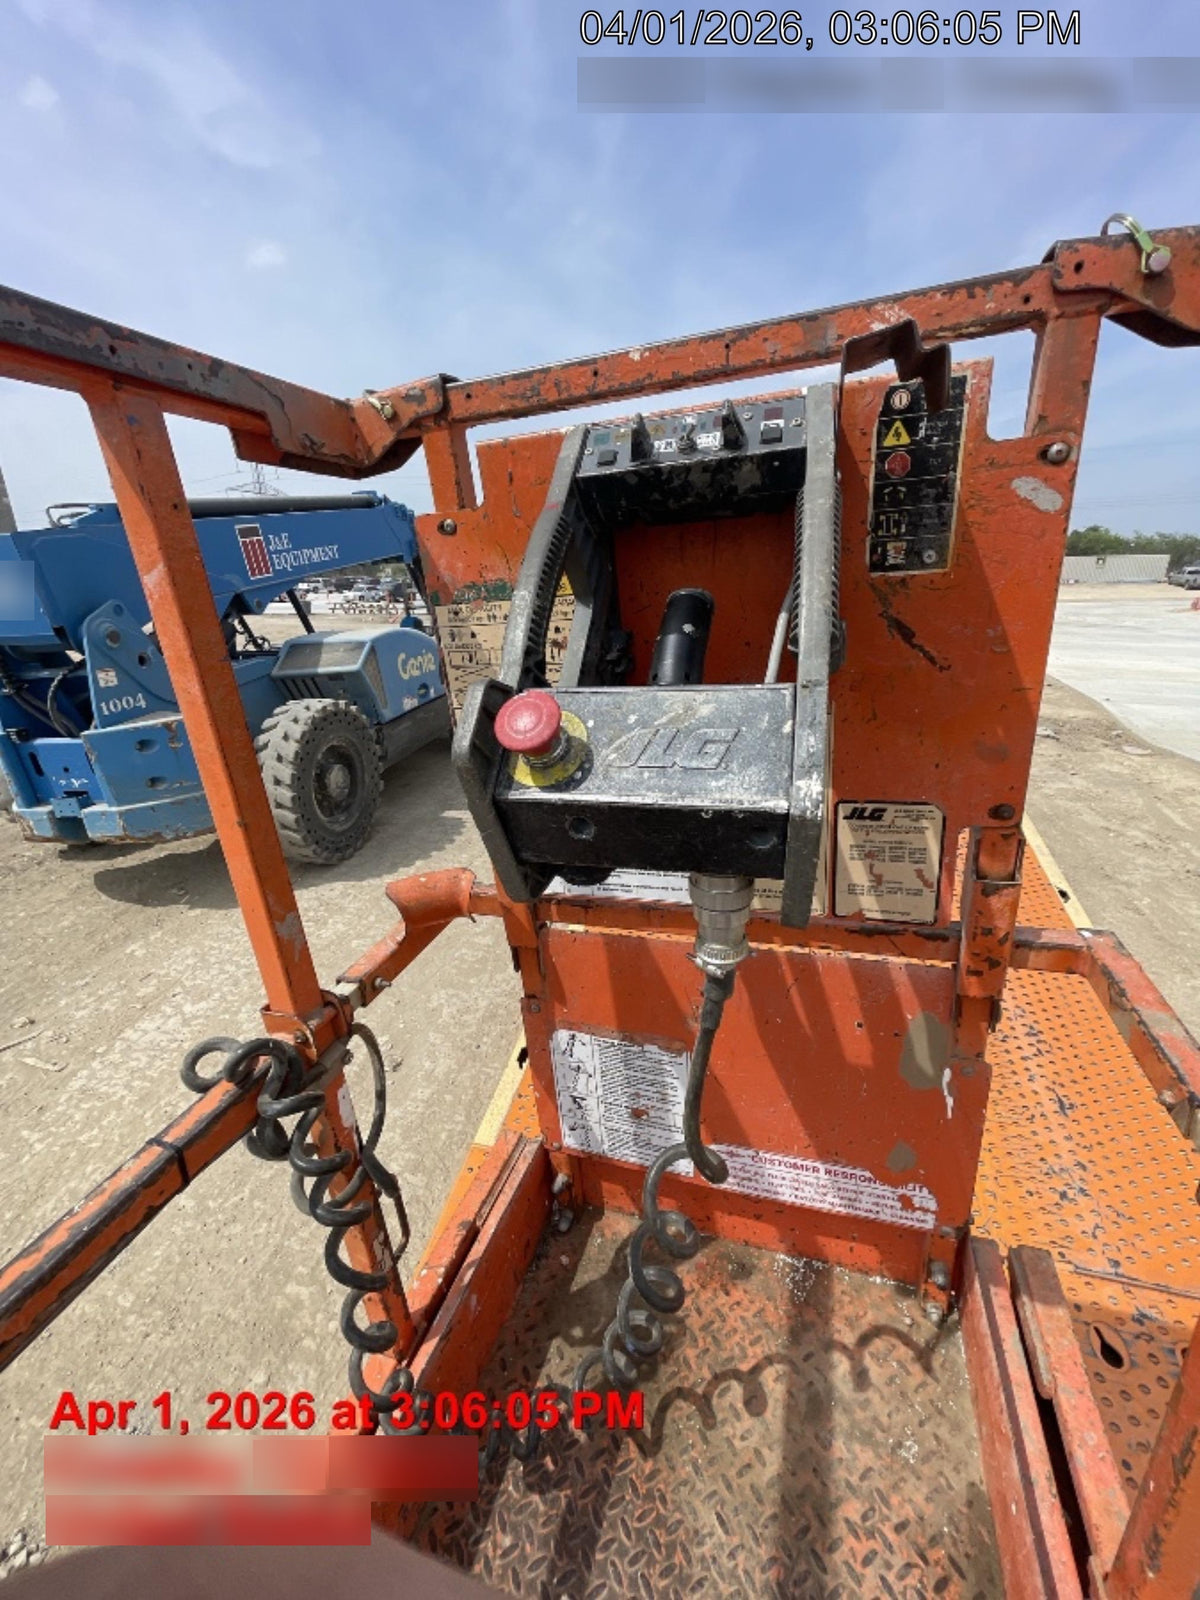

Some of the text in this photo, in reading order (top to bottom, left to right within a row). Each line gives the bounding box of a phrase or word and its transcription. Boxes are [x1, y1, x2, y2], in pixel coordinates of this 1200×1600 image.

[267, 532, 292, 552] J&E
[271, 544, 339, 572] EQUIPMENT
[100, 692, 147, 716] 1004
[602, 727, 741, 770] JLG
[842, 806, 888, 822] JLG
